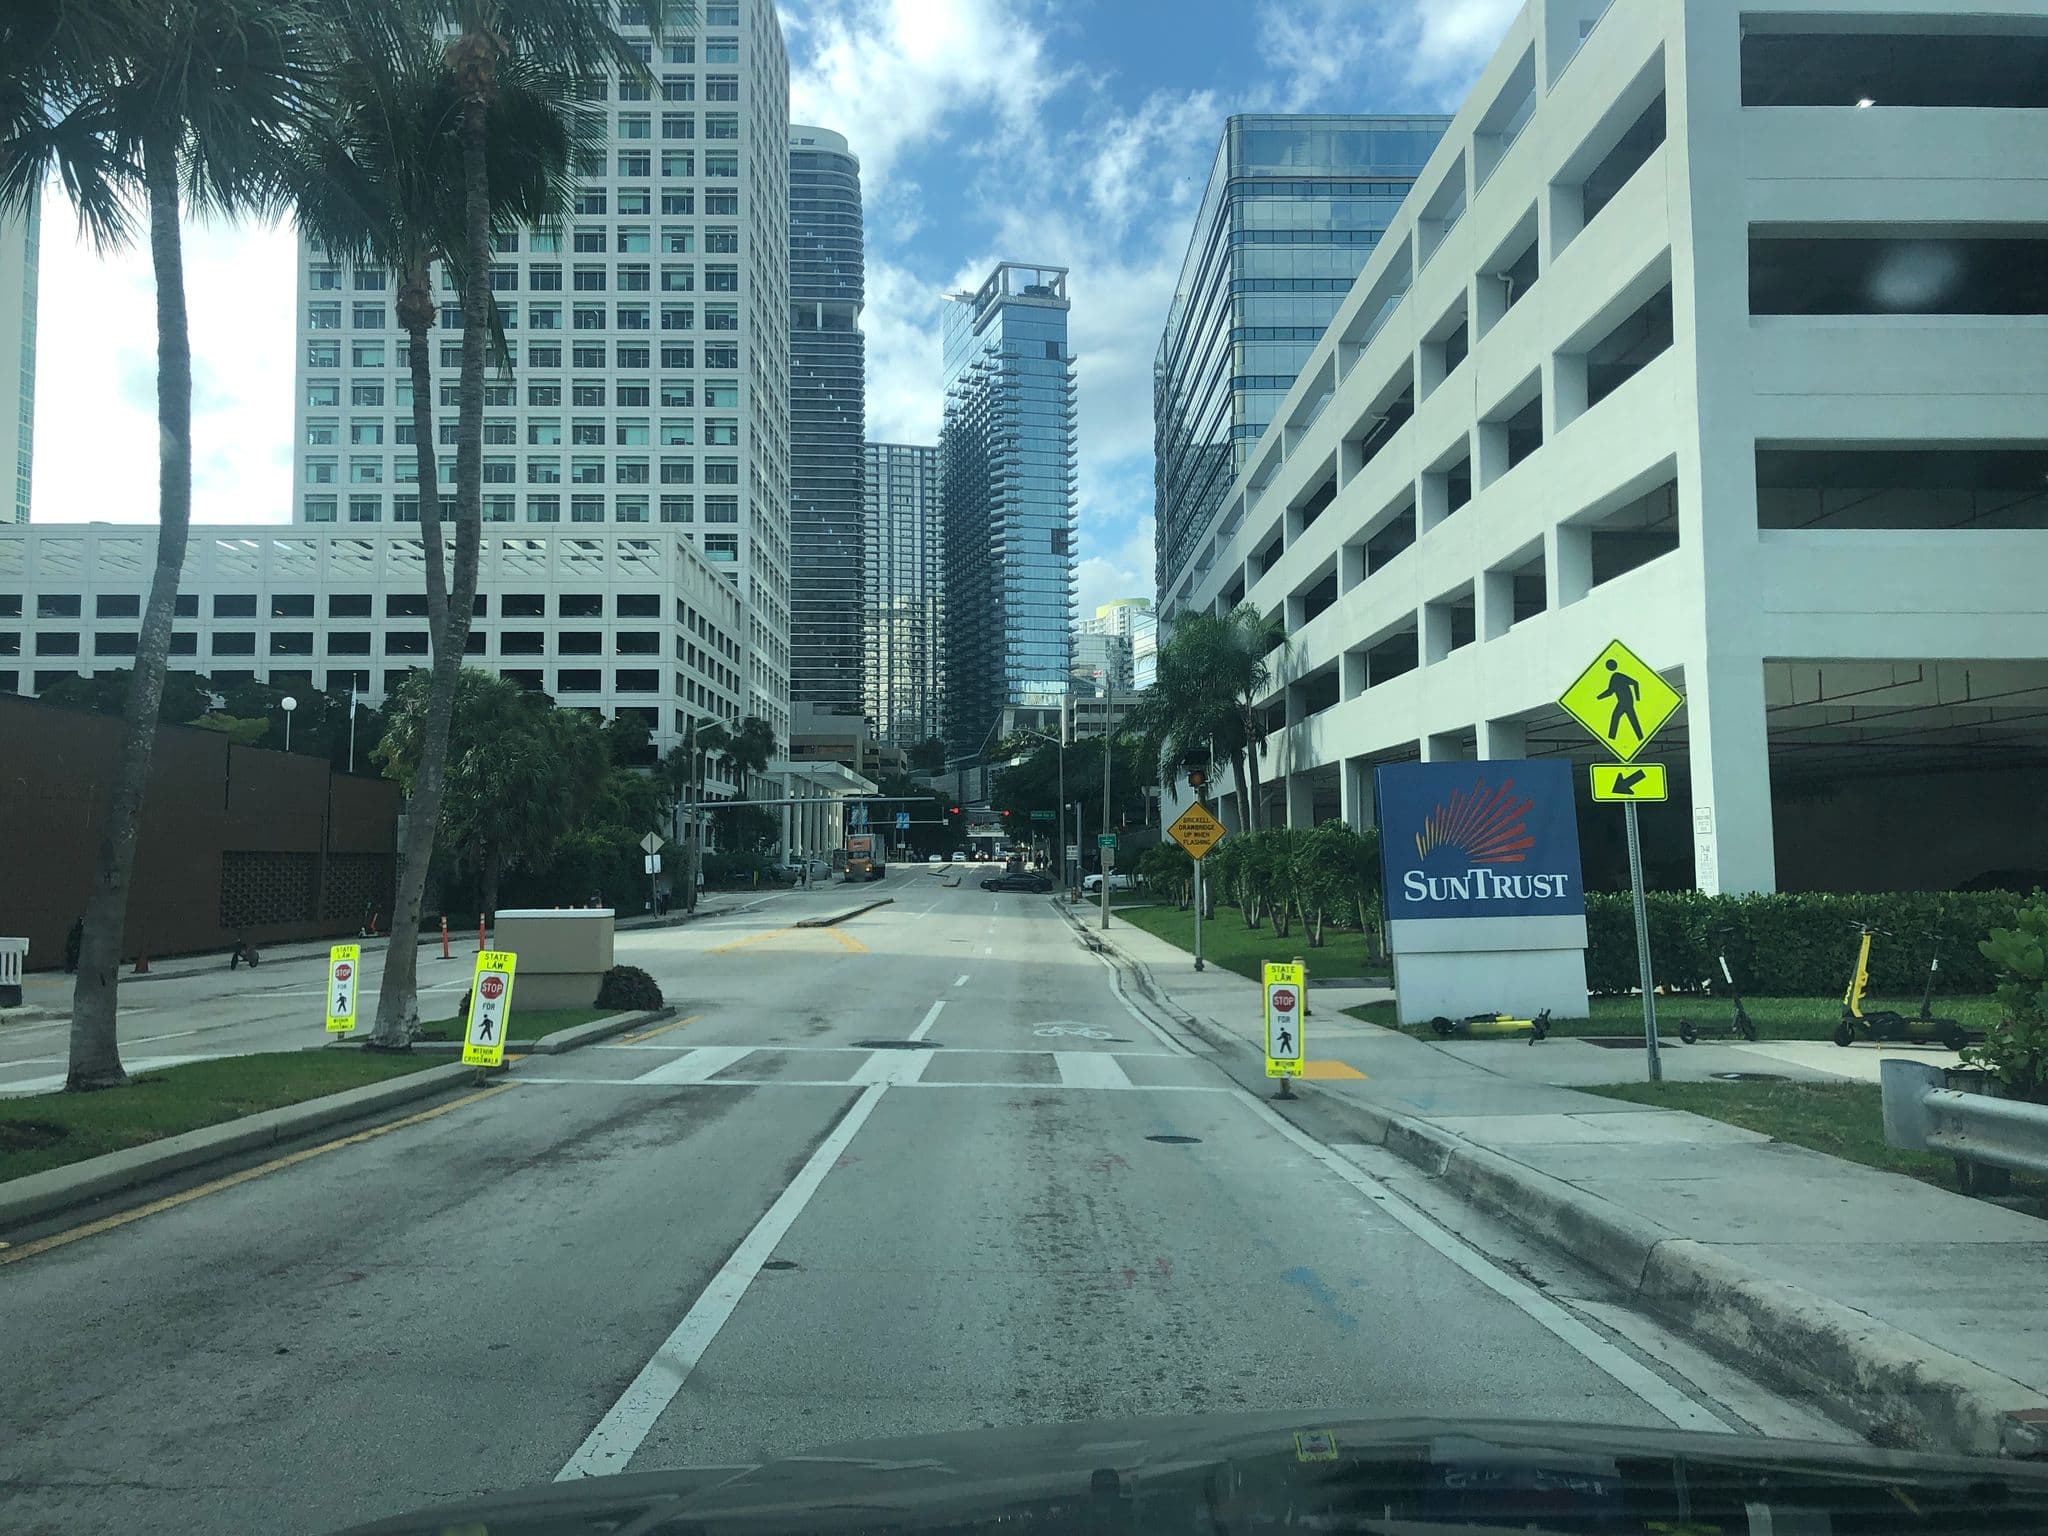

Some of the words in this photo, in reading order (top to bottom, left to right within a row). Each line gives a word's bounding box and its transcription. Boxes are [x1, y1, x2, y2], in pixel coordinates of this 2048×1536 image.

[484, 952, 509, 961] STATE
[486, 961, 504, 970] LAW
[336, 969, 352, 977] STOP
[1274, 973, 1292, 981] LAW
[482, 982, 503, 993] STOP
[1273, 996, 1295, 1006] STOP
[482, 1002, 496, 1011] FOR
[1277, 1015, 1291, 1023] FOR
[472, 1047, 494, 1055] WITHIN
[464, 1055, 499, 1064] CROSSWALK
